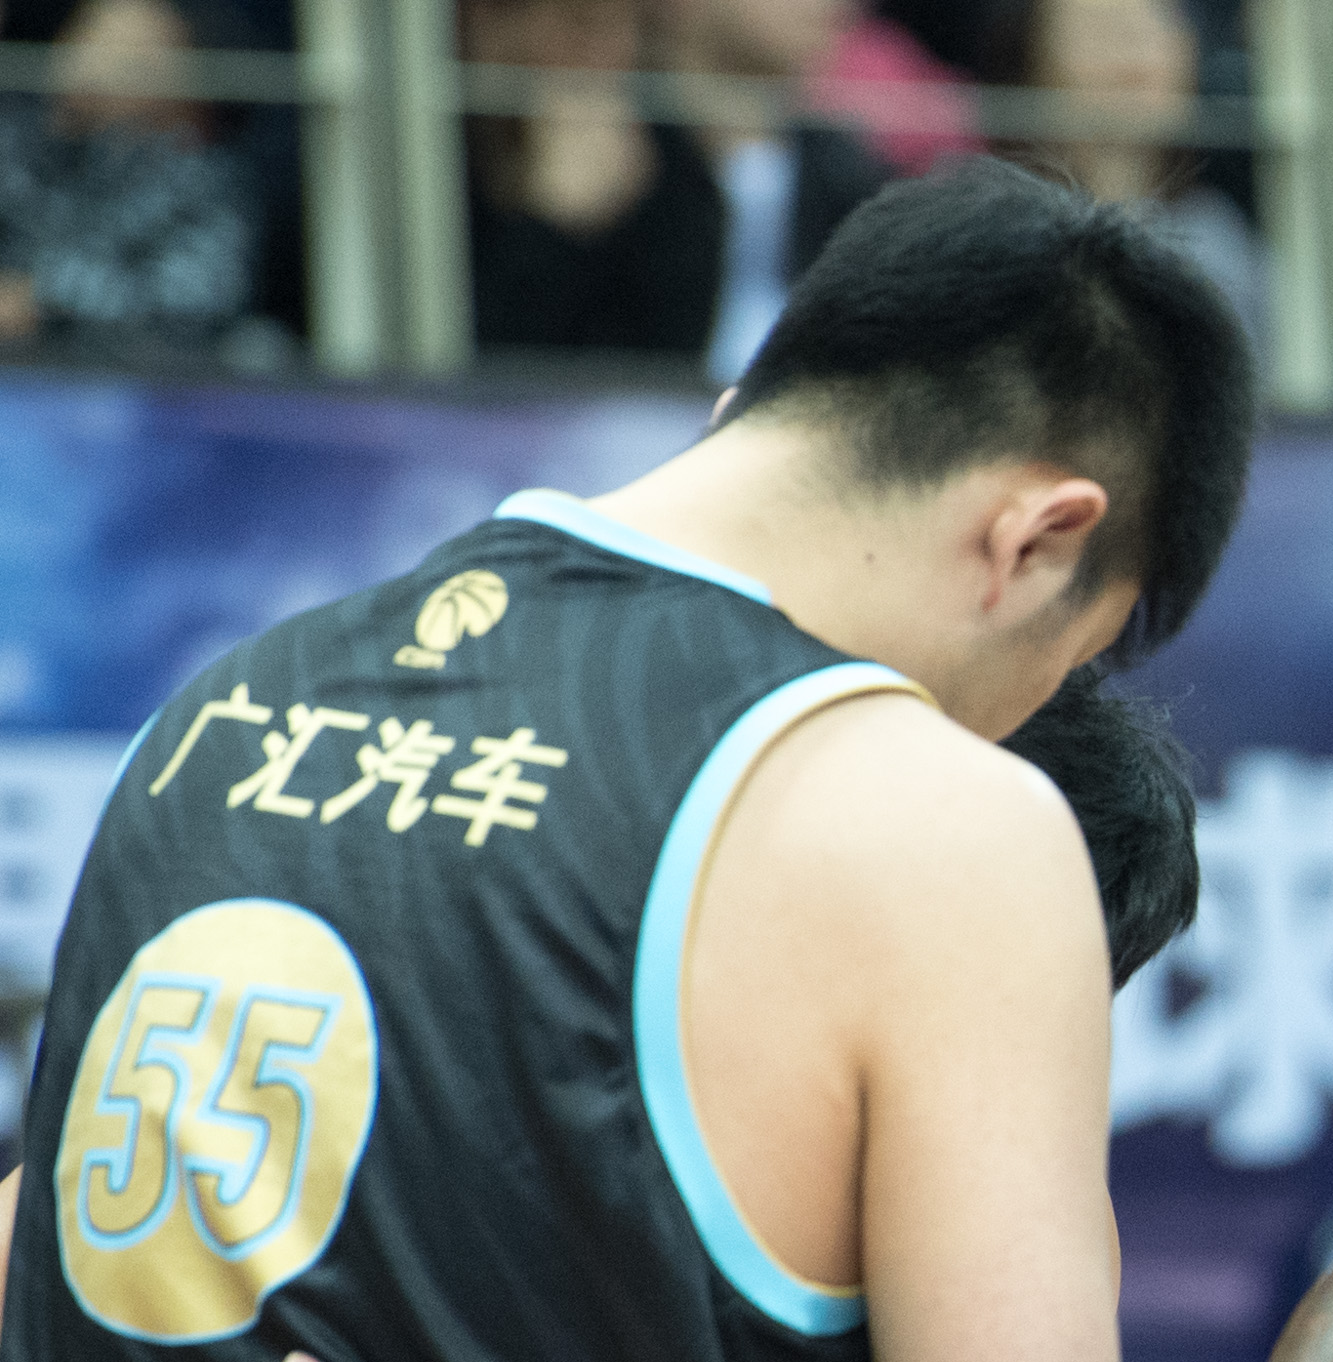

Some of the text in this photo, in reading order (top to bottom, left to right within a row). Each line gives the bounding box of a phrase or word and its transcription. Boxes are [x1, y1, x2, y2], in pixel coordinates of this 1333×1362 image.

[149, 683, 568, 847] 广汇汽车
[77, 974, 342, 1259] 55
